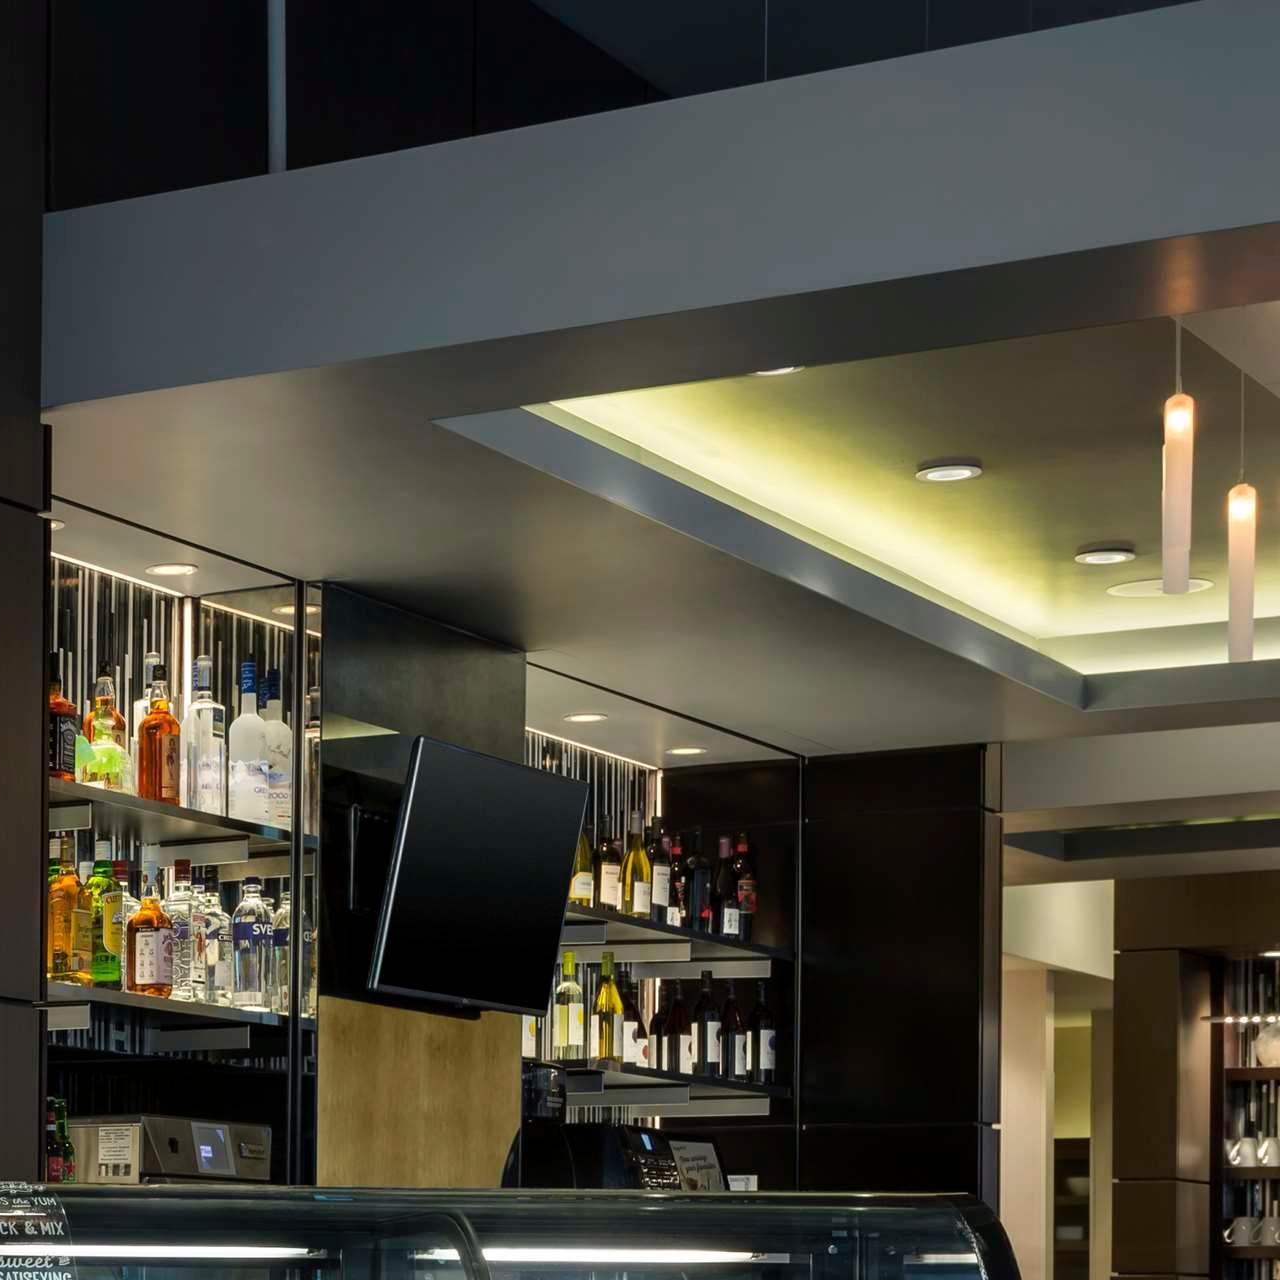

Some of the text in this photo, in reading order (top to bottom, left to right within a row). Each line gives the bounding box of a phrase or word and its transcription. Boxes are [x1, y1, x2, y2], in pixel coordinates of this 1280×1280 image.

[252, 923, 273, 935] SVE
[31, 1197, 57, 1206] YUM
[24, 1220, 38, 1235] &
[40, 1221, 65, 1236] MIX
